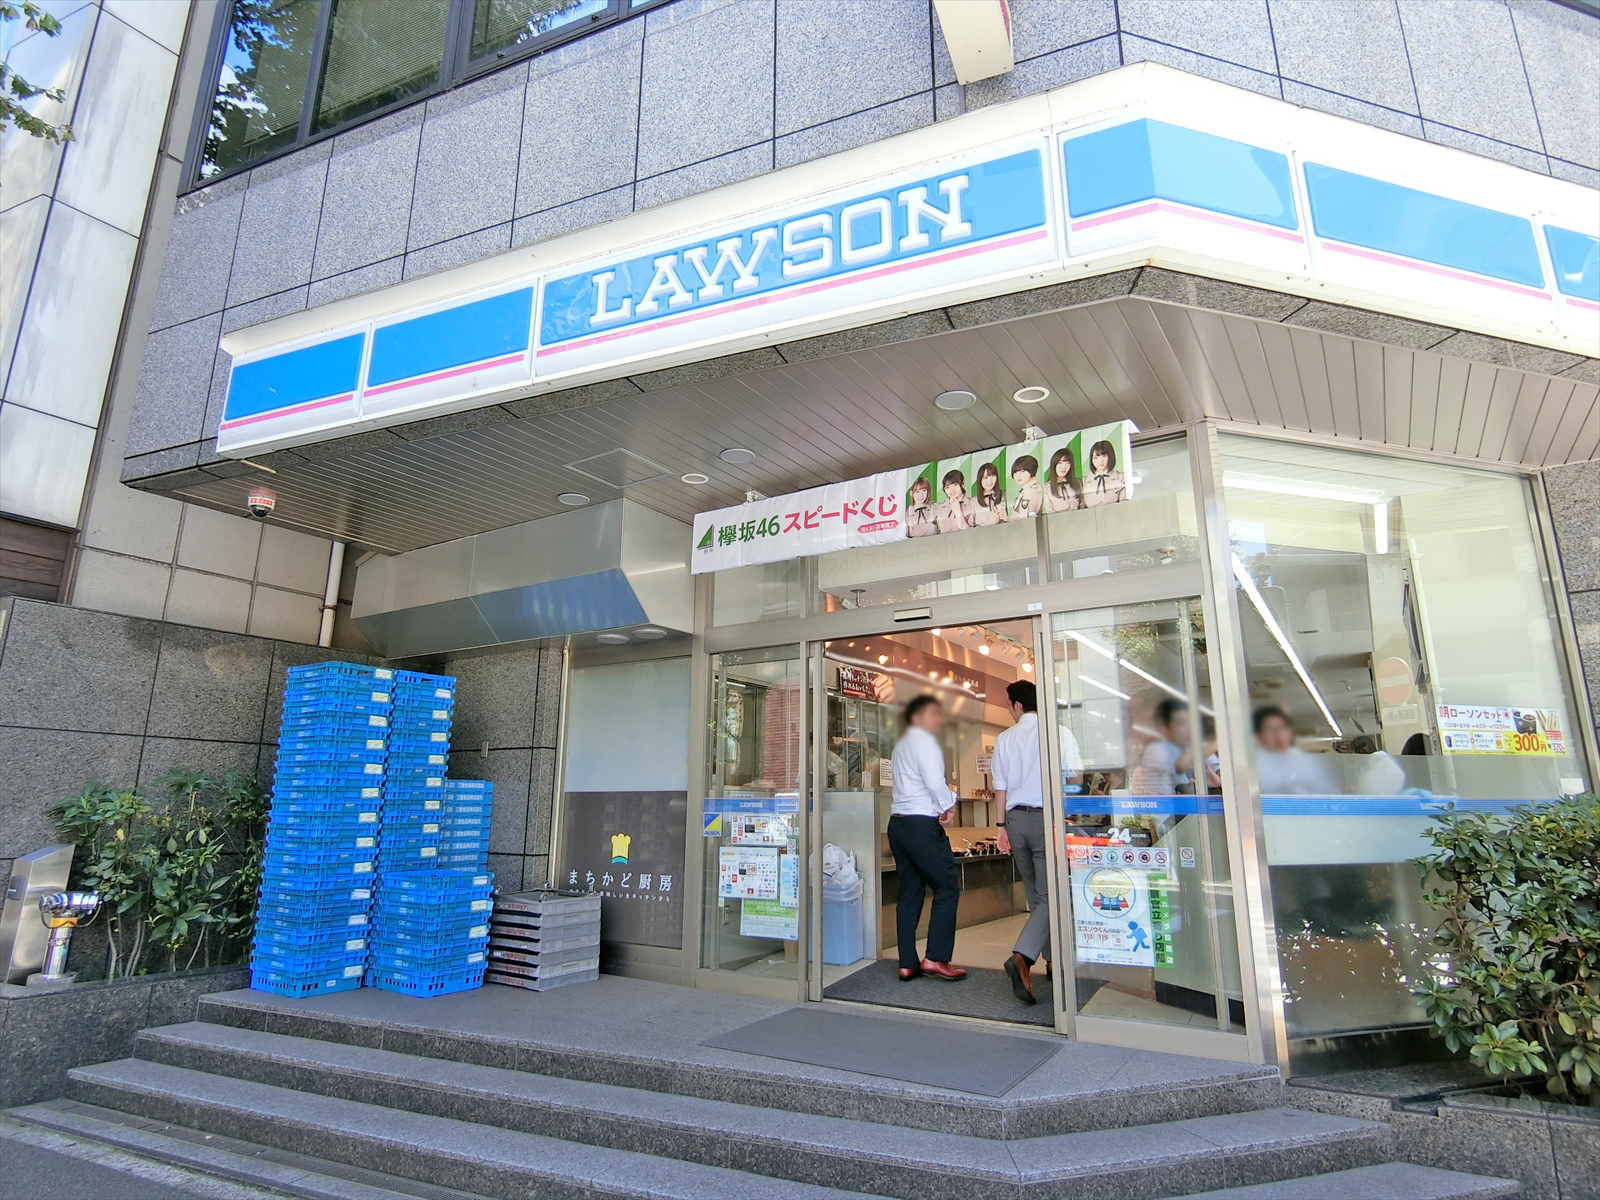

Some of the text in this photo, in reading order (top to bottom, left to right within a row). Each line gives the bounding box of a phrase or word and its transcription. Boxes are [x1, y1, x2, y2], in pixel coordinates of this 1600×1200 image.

[589, 173, 972, 328] LAWSON
[1439, 706, 1501, 719] 朝ローソンセット
[1107, 827, 1132, 843] 24
[569, 869, 672, 892] まちかど厨房
